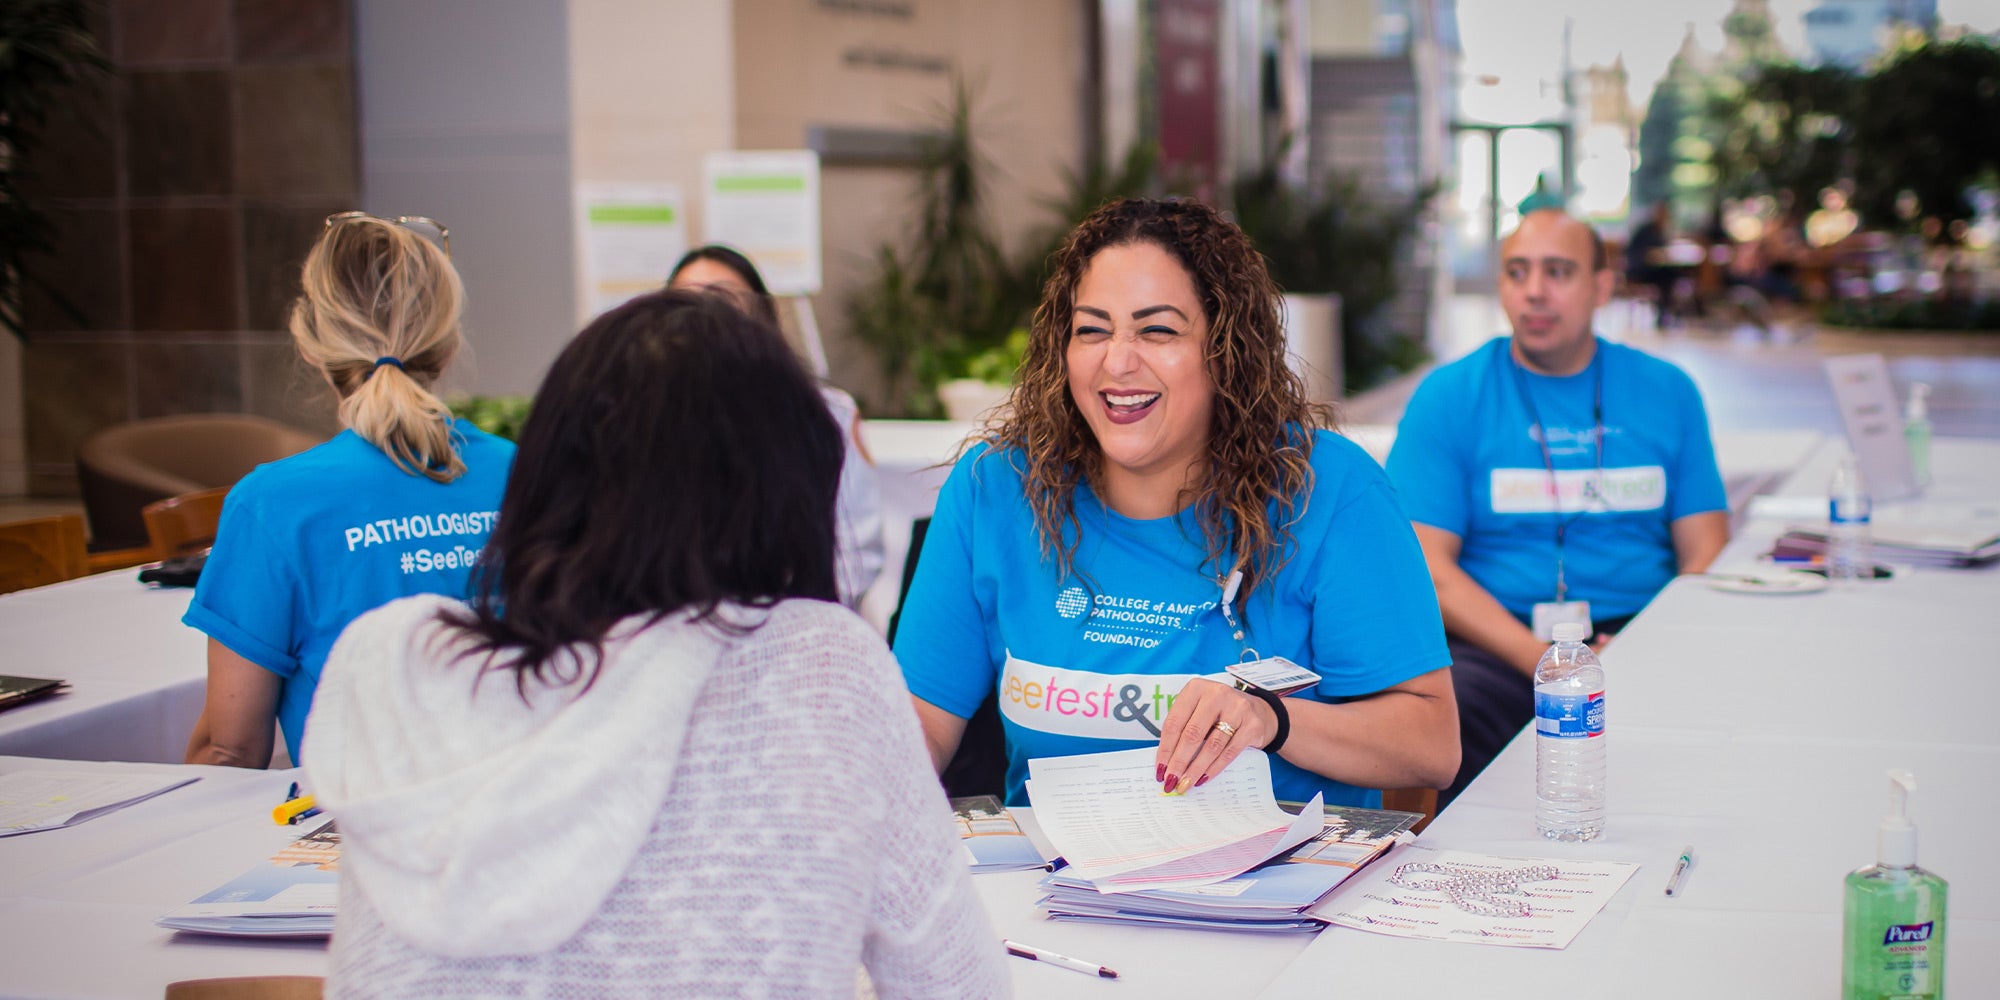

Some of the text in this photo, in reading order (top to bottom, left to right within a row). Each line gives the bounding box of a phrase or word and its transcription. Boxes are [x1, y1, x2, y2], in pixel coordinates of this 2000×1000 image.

[1094, 593, 1151, 611] COLLEGE
[1152, 601, 1166, 614] of
[1090, 607, 1182, 628] PATHOLOGISTS
